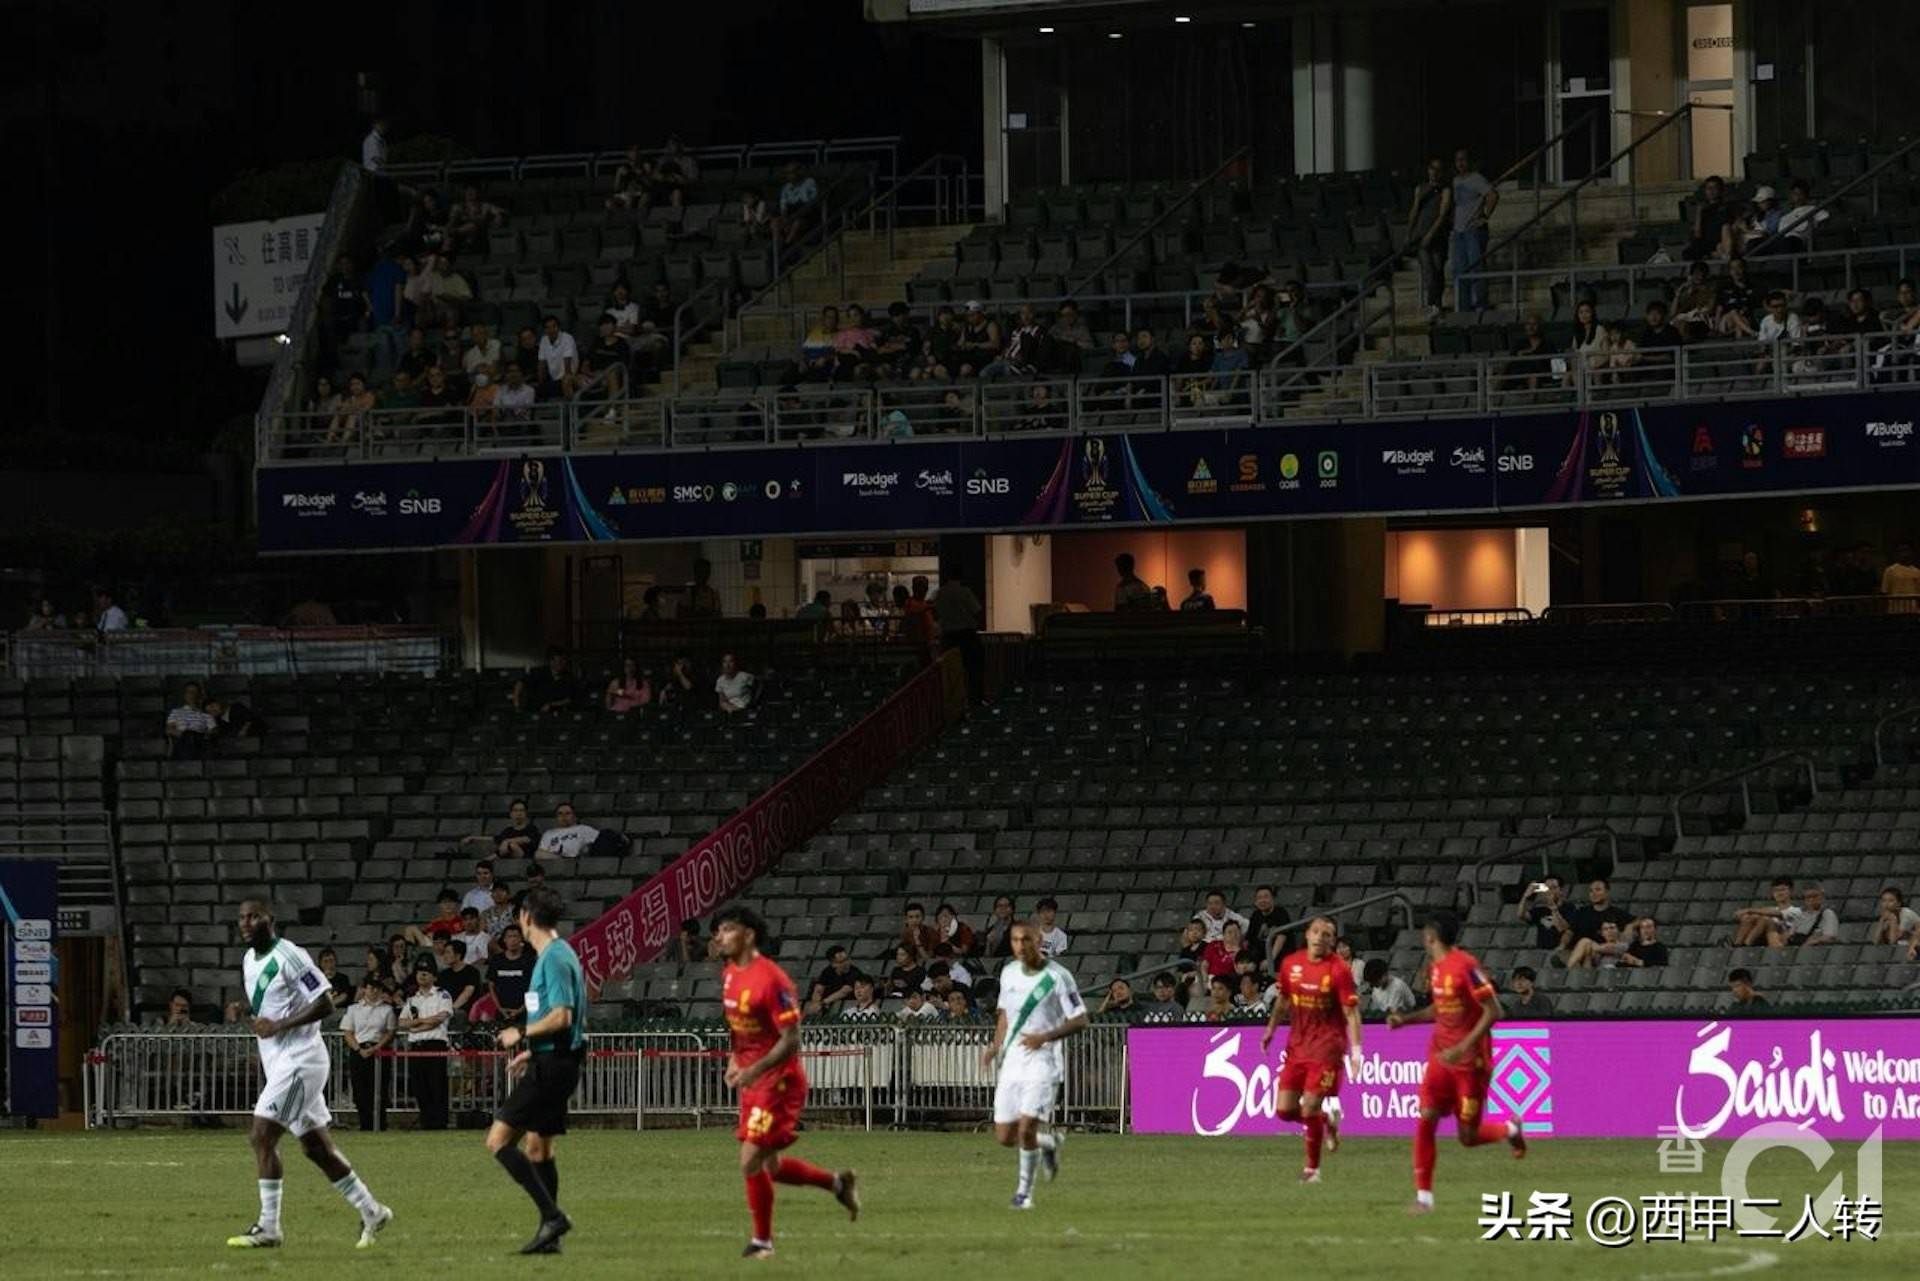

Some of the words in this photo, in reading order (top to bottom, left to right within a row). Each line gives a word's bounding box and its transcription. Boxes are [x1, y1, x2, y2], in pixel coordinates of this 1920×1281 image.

[1878, 421, 1915, 440] Budget
[1398, 449, 1434, 467] Budget
[1497, 454, 1535, 472] SNB
[858, 472, 899, 489] Budget
[966, 477, 1010, 495] SNB
[297, 492, 336, 510] Budget
[673, 485, 702, 501] SMC
[399, 498, 443, 515] SNB
[676, 821, 756, 922] HONG
[18, 928, 48, 938] SNB
[1361, 1091, 1383, 1119] to
[1386, 1087, 1422, 1119] Ara
[1863, 1090, 1888, 1120] to
[1891, 1086, 1920, 1119] Ar
